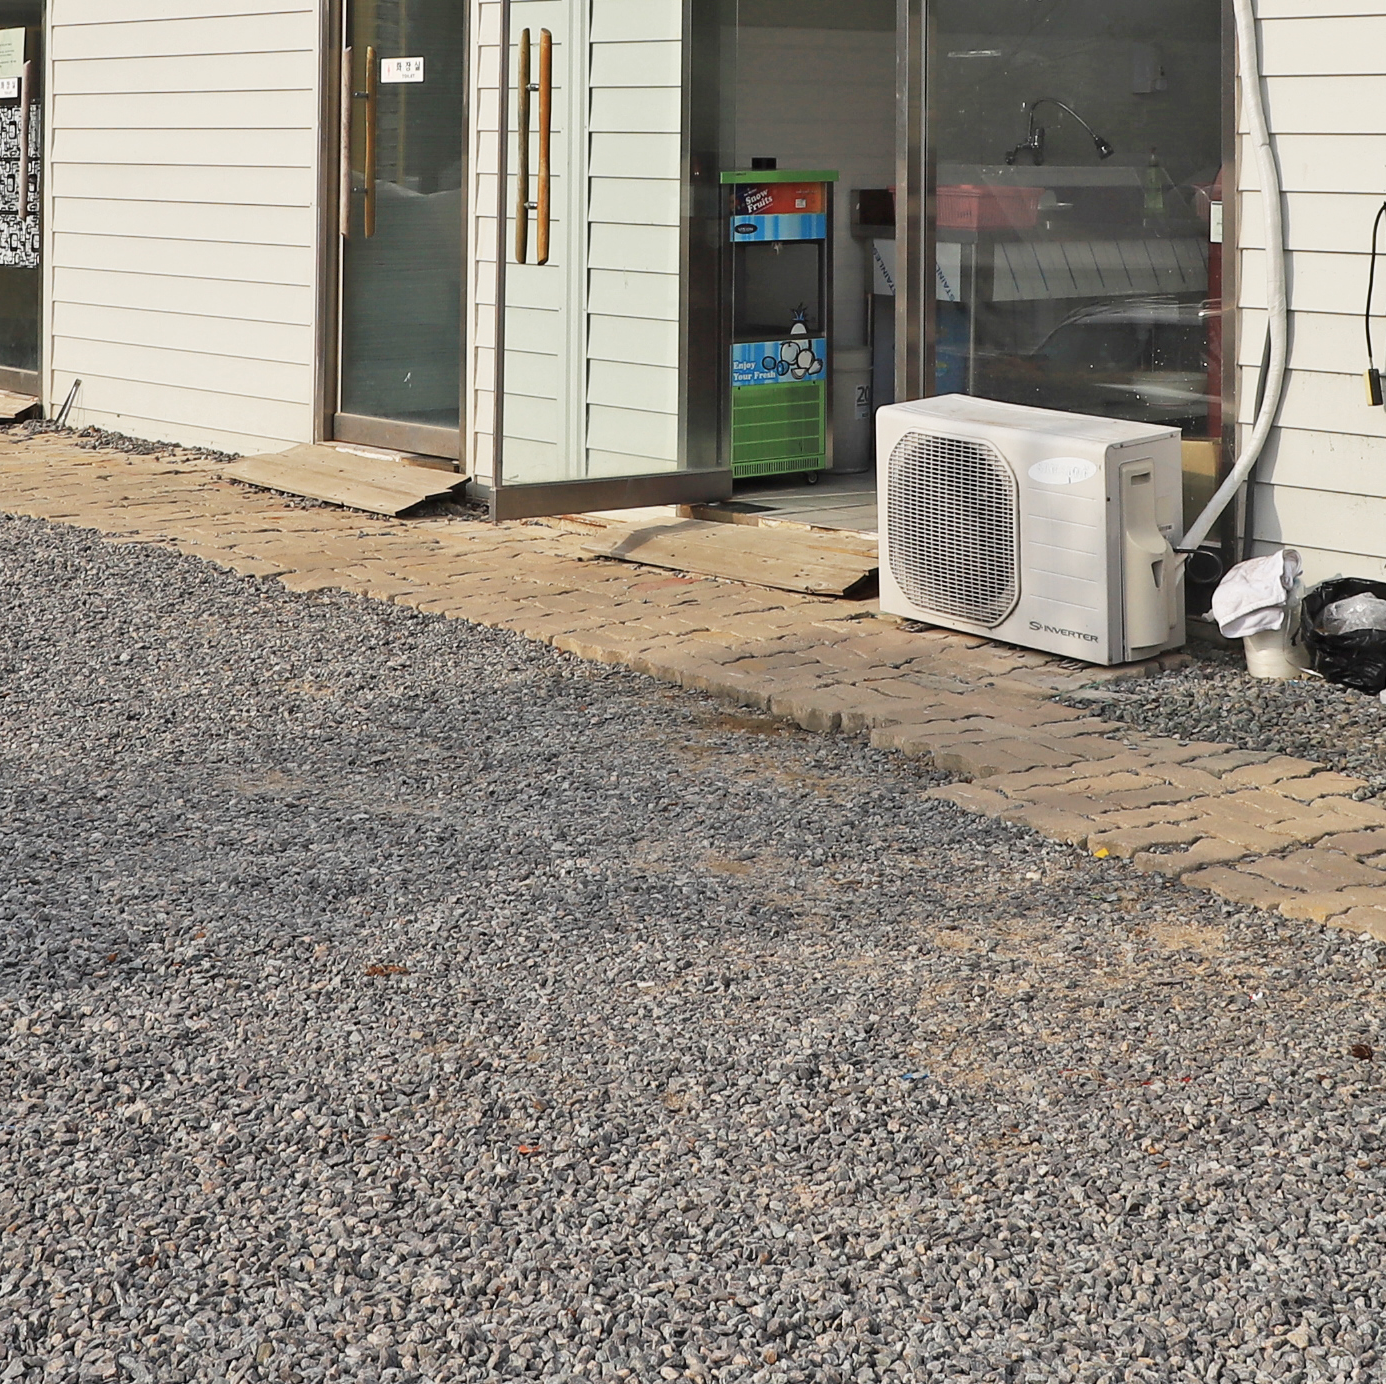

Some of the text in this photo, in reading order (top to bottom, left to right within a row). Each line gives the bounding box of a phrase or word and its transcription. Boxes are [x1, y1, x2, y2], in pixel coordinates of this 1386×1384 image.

[396, 60, 421, 72] 화장실
[745, 189, 768, 206] Snow
[747, 196, 773, 213] Fruits
[733, 359, 756, 371] Enjoy
[733, 370, 776, 382] Your Fresh
